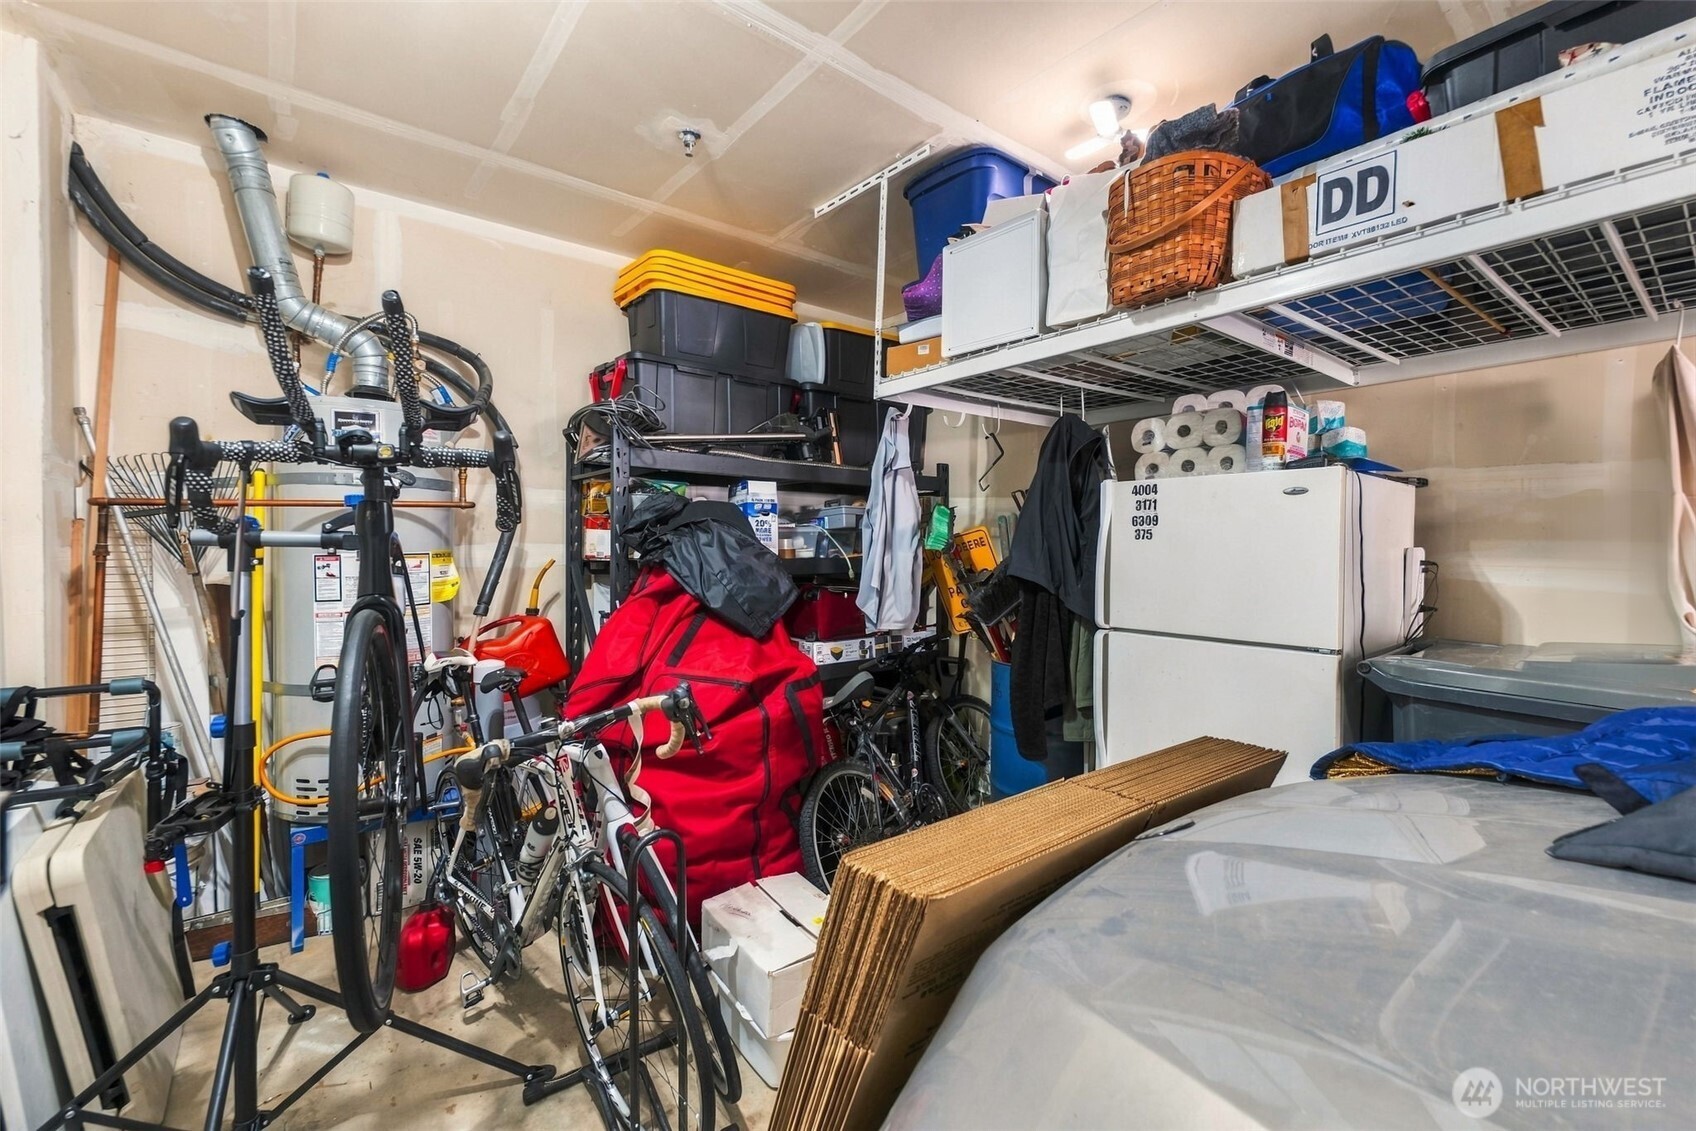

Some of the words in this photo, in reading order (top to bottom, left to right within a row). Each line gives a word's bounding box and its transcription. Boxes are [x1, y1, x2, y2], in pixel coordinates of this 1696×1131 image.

[1321, 165, 1390, 226] DD
[1391, 216, 1408, 227] LED
[1131, 484, 1158, 496] 4004
[1135, 499, 1157, 511] 3171
[1131, 515, 1158, 527] 6309
[1134, 529, 1153, 540] 375
[413, 837, 423, 856] SAE
[413, 856, 423, 885] 5W-20
